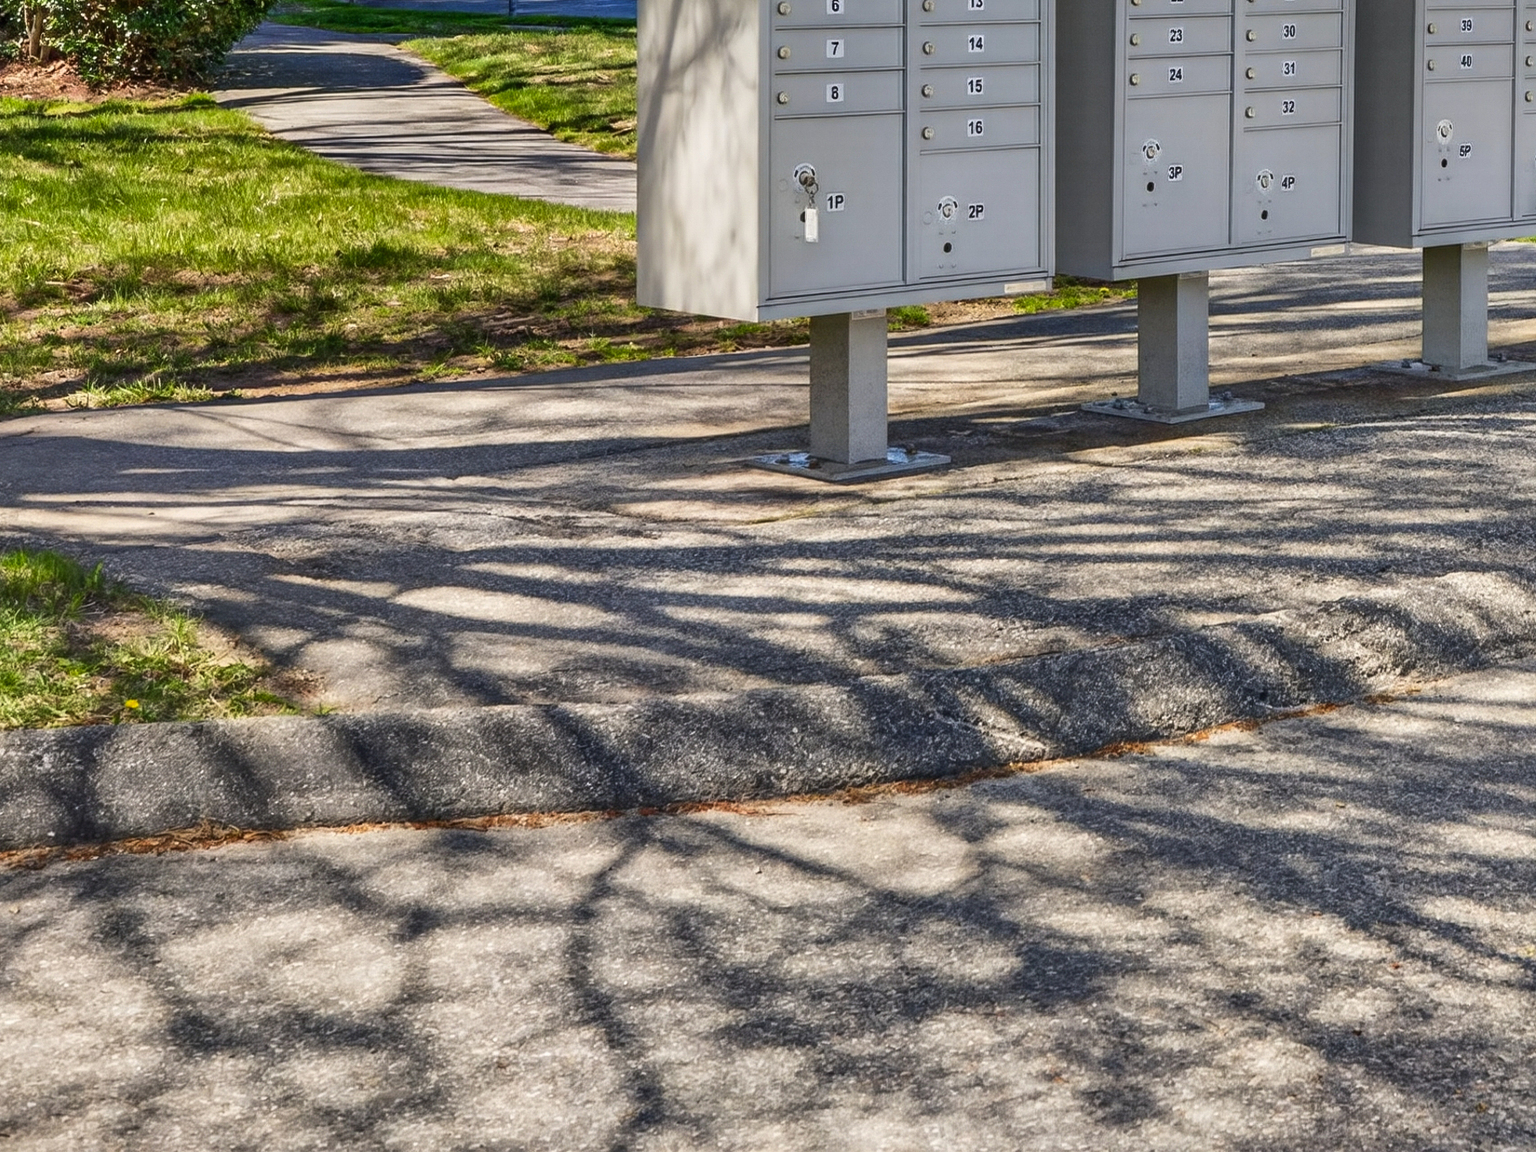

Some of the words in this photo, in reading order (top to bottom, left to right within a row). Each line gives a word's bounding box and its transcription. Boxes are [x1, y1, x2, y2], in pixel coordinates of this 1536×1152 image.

[1283, 24, 1296, 38] 30
[1461, 19, 1472, 31] 39
[1169, 28, 1183, 42] 23
[831, 41, 840, 56] 7
[969, 36, 984, 51] 14
[1460, 55, 1472, 67] 40
[1169, 68, 1183, 81] 24
[1284, 62, 1295, 75] 31
[831, 85, 839, 100] 8
[968, 79, 983, 93] 15
[1282, 100, 1295, 114] 32
[968, 120, 983, 135] 16
[1168, 166, 1183, 180] 3P
[1281, 176, 1296, 189] 4P
[827, 194, 844, 210] 1P
[968, 204, 984, 219] 2P
